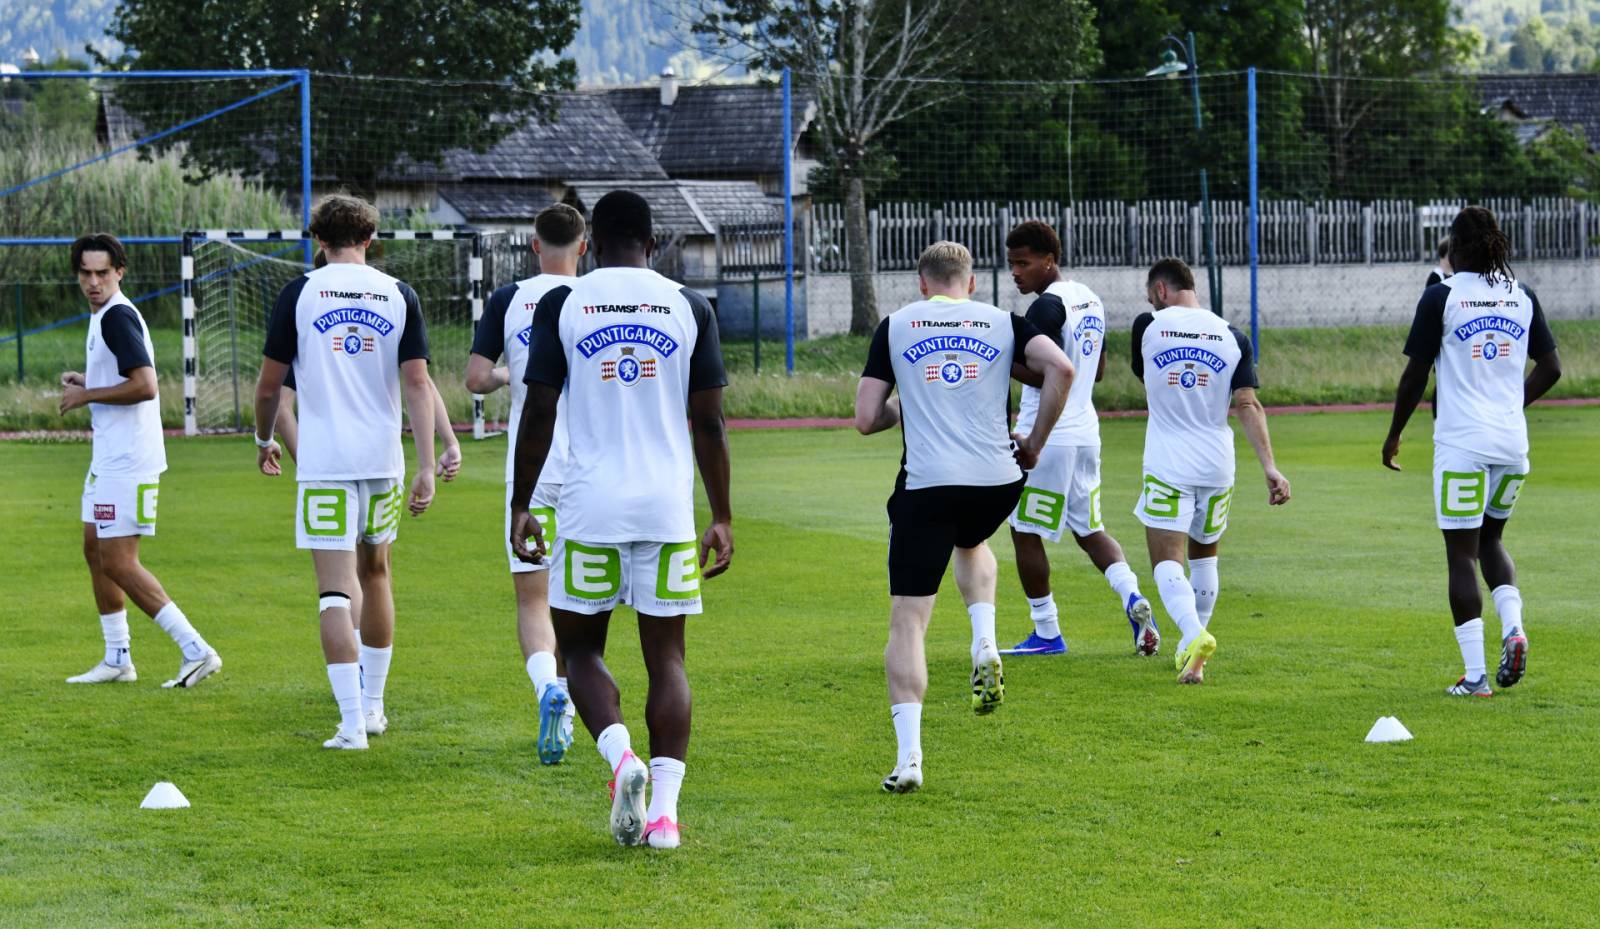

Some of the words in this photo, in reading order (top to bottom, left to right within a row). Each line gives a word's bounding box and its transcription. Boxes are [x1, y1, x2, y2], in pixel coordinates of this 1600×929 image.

[316, 309, 390, 334] PUNTIGAMER
[1458, 317, 1522, 339] PUNTIGAMER
[580, 326, 674, 357] PUNTIGAMER
[906, 337, 996, 362] PUNTIGAMER
[1156, 348, 1223, 372] PUNTIGAMER
[1025, 492, 1057, 524] E
[1446, 478, 1479, 511] E
[308, 495, 339, 530] E
[571, 550, 612, 592] E
[666, 549, 699, 592] E
